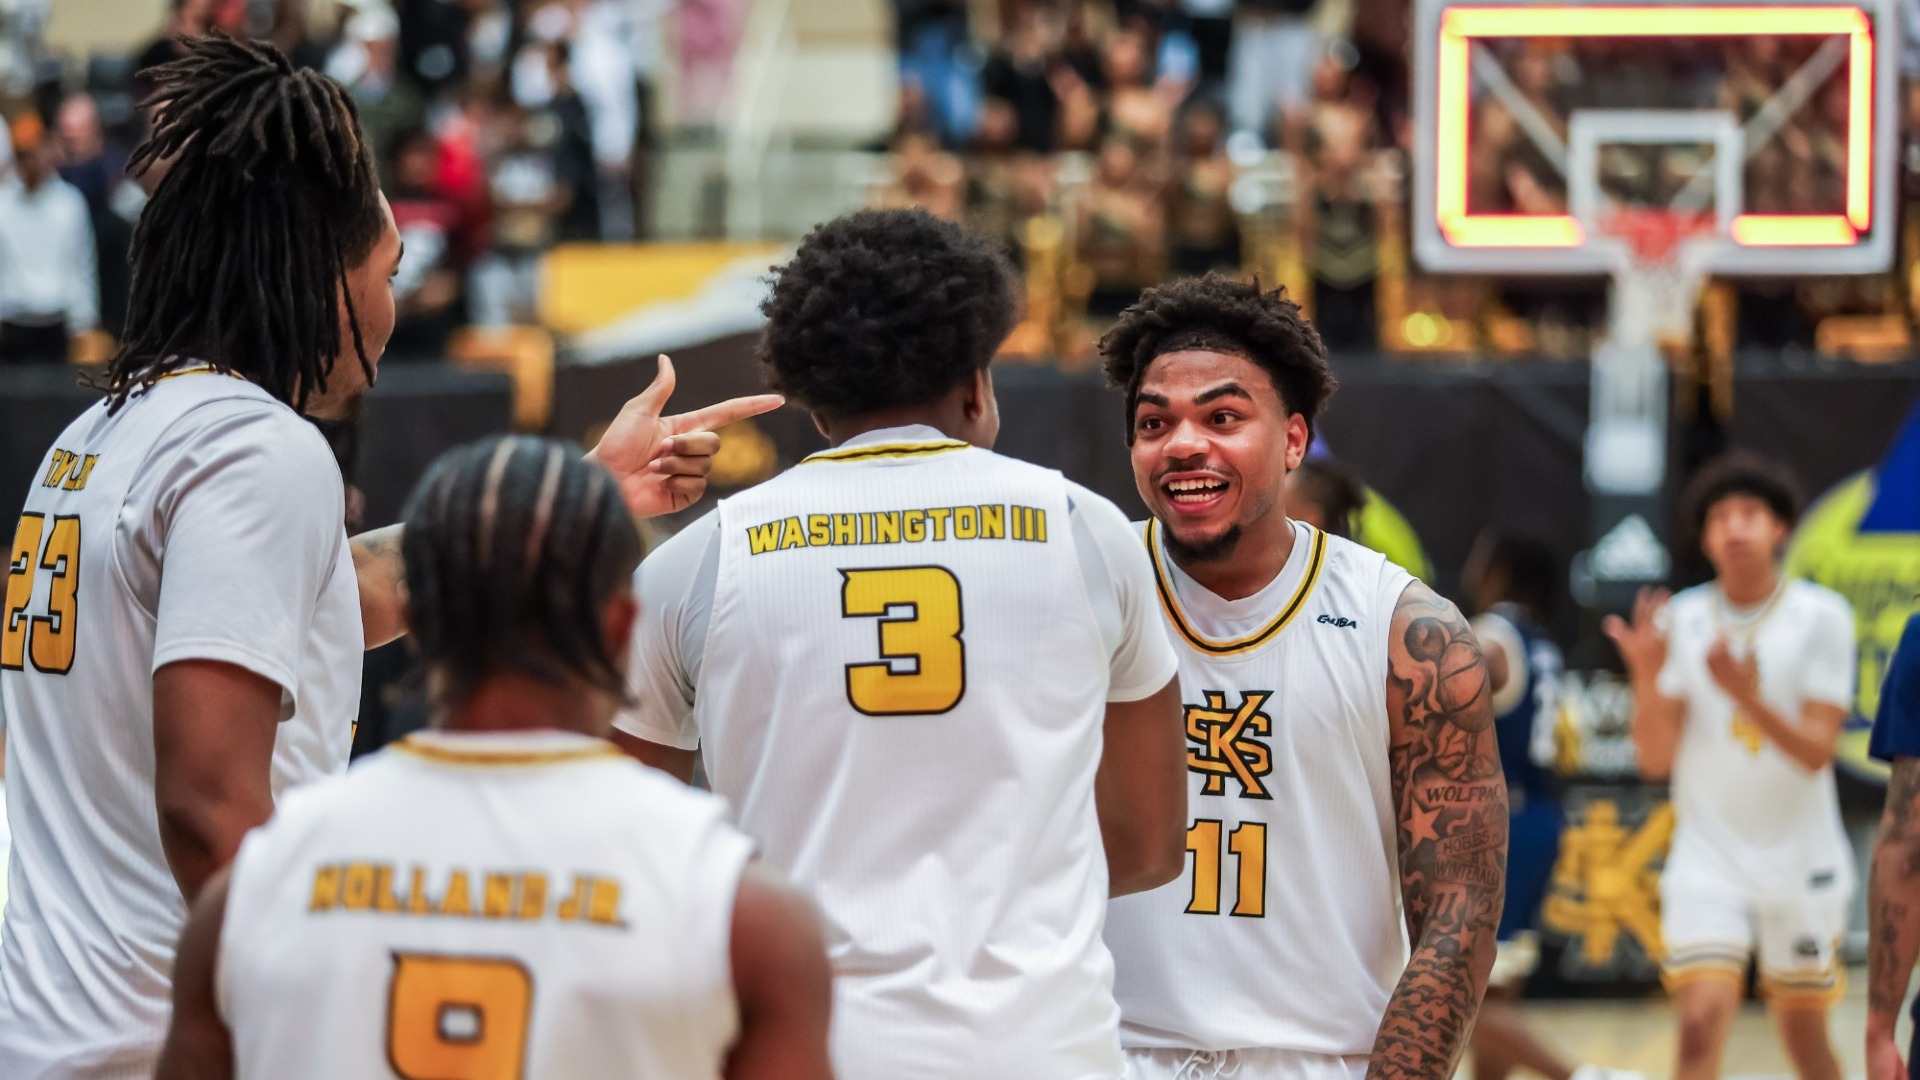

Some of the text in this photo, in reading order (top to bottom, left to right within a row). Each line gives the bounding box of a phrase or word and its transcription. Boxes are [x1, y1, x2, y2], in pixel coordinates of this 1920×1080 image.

[746, 503, 1048, 556] WASHINGTON III
[1, 510, 82, 676] 23
[836, 564, 967, 717] 3
[1425, 783, 1502, 803] WOLFPAC
[1184, 818, 1268, 918] 11
[1443, 828, 1490, 854] HOBBS
[309, 863, 548, 921] HOLLAND
[384, 947, 536, 1080] 9
